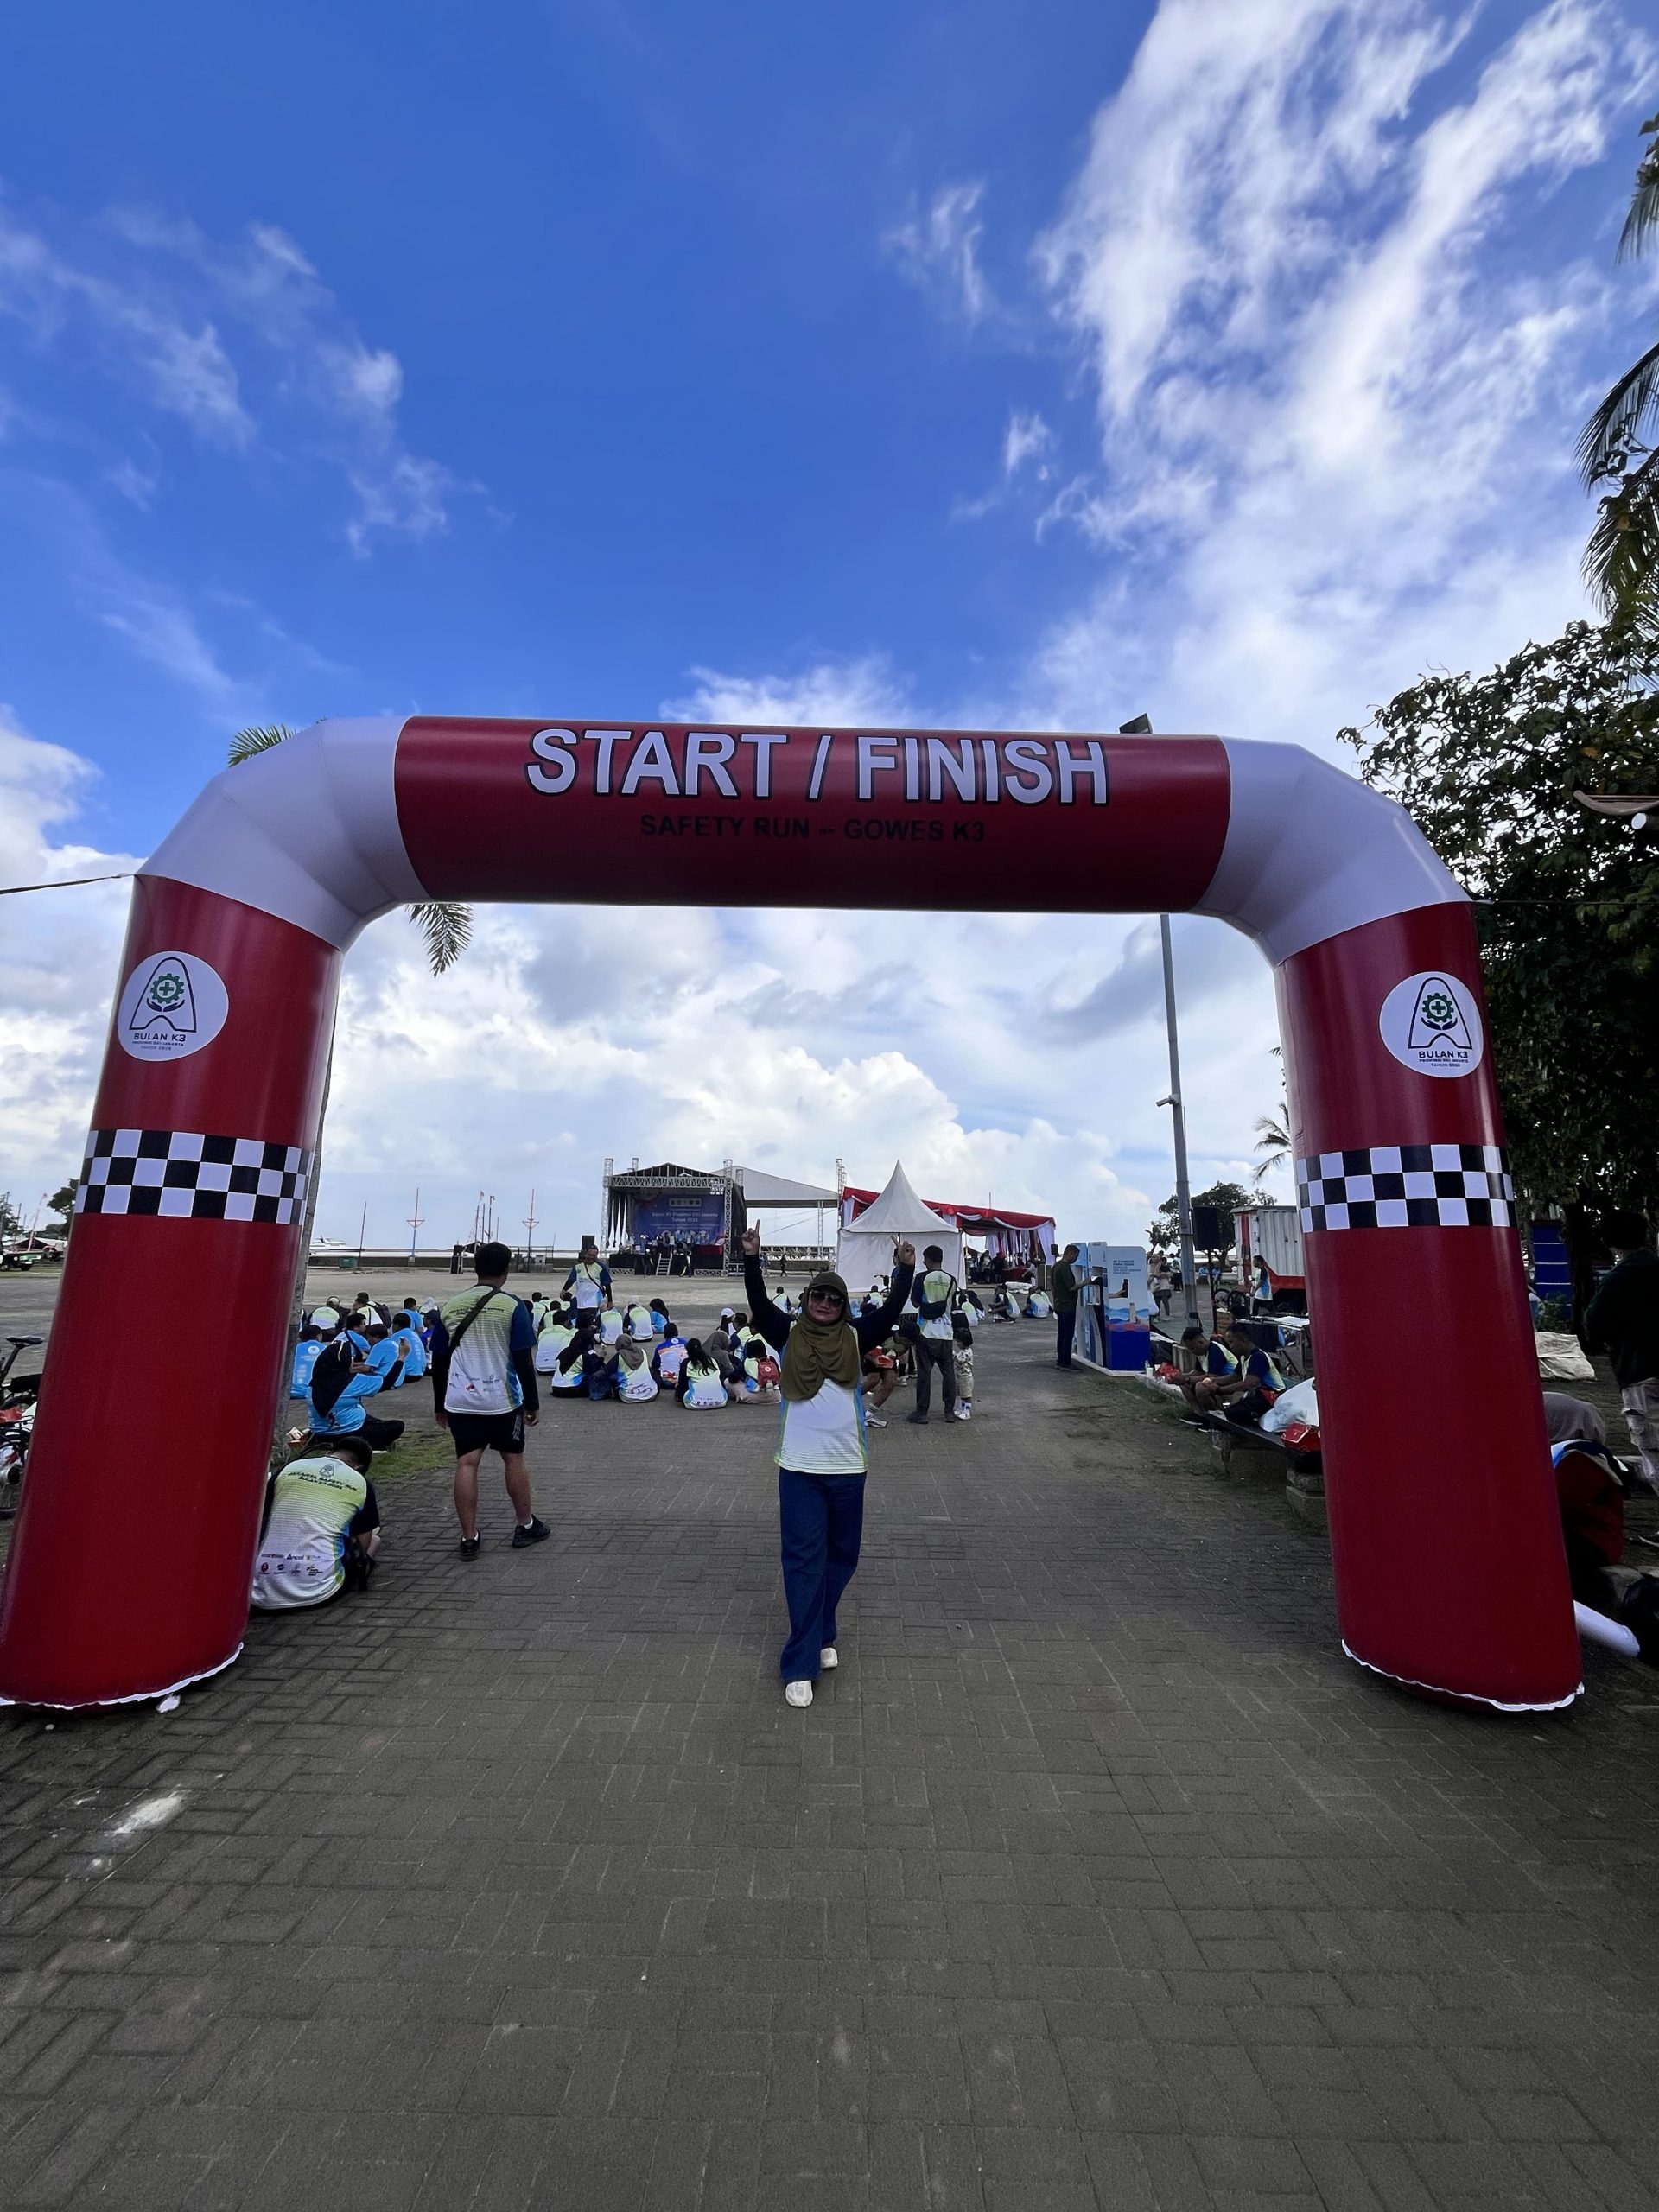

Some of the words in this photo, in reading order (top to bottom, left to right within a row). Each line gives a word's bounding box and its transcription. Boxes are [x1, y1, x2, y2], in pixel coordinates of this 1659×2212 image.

[525, 728, 790, 800] START
[805, 734, 832, 802] /
[855, 734, 1109, 805] FINISH
[639, 814, 746, 837] SAFETY
[754, 817, 810, 839] RUN
[844, 817, 944, 842] GOWES
[954, 820, 986, 843] K3
[171, 1033, 187, 1042] K3
[1418, 1050, 1454, 1058] BULAN
